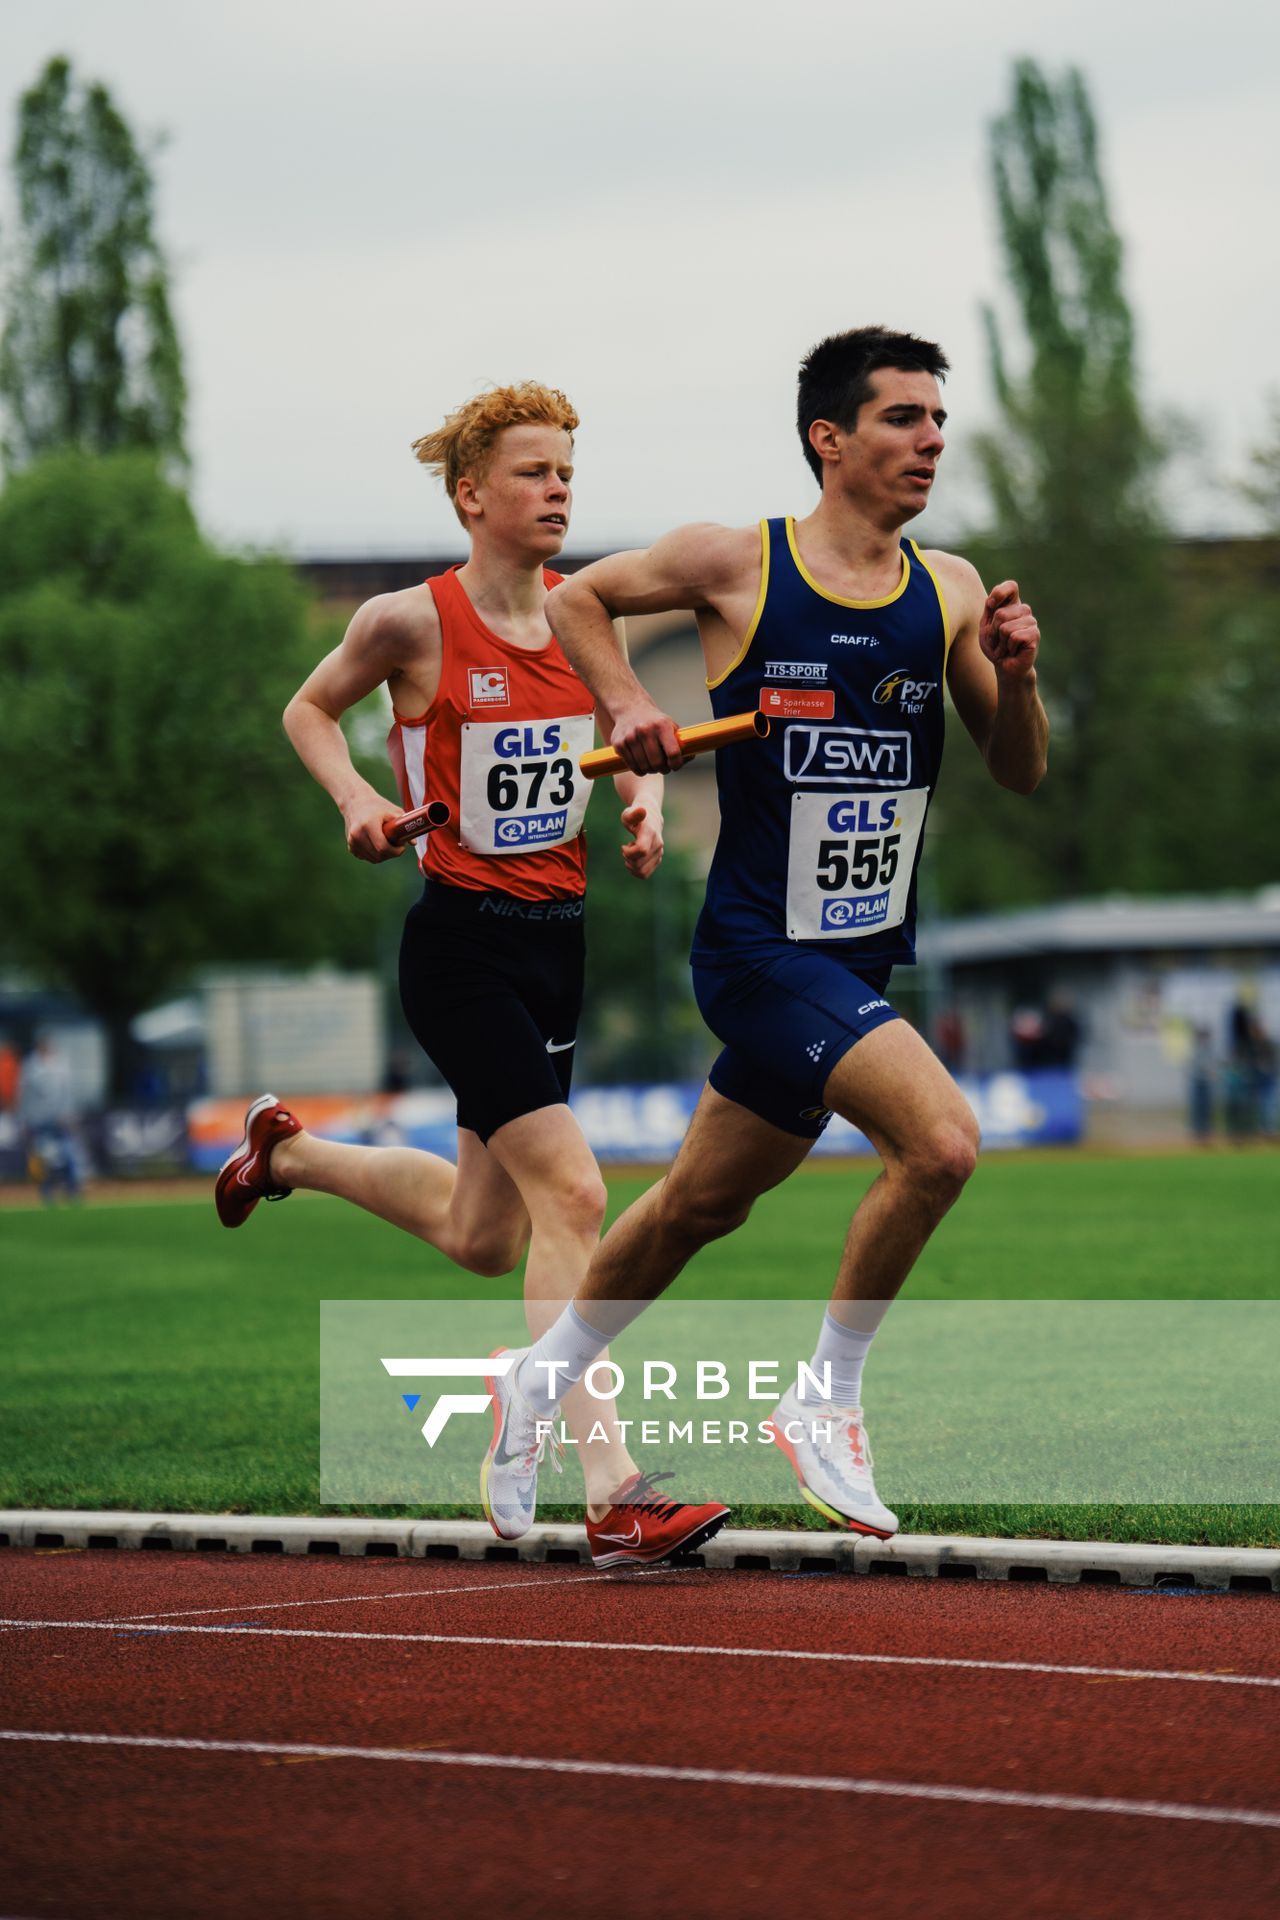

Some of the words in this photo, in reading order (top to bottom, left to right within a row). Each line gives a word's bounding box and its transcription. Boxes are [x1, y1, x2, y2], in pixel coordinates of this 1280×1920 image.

[830, 634, 869, 646] CRAFT
[764, 665, 828, 678] TTS-SPORT
[900, 680, 938, 700] PST
[783, 699, 825, 709] Sparkasse
[899, 700, 925, 714] Trier
[783, 708, 801, 716] Trier
[823, 740, 901, 773] SWT
[487, 758, 574, 811] 673
[528, 816, 565, 834] PLAN
[528, 831, 563, 840] INTERNATIONAL
[816, 833, 901, 892] 555
[855, 897, 887, 916] PLAN
[855, 913, 886, 924] INTERNATIONAL
